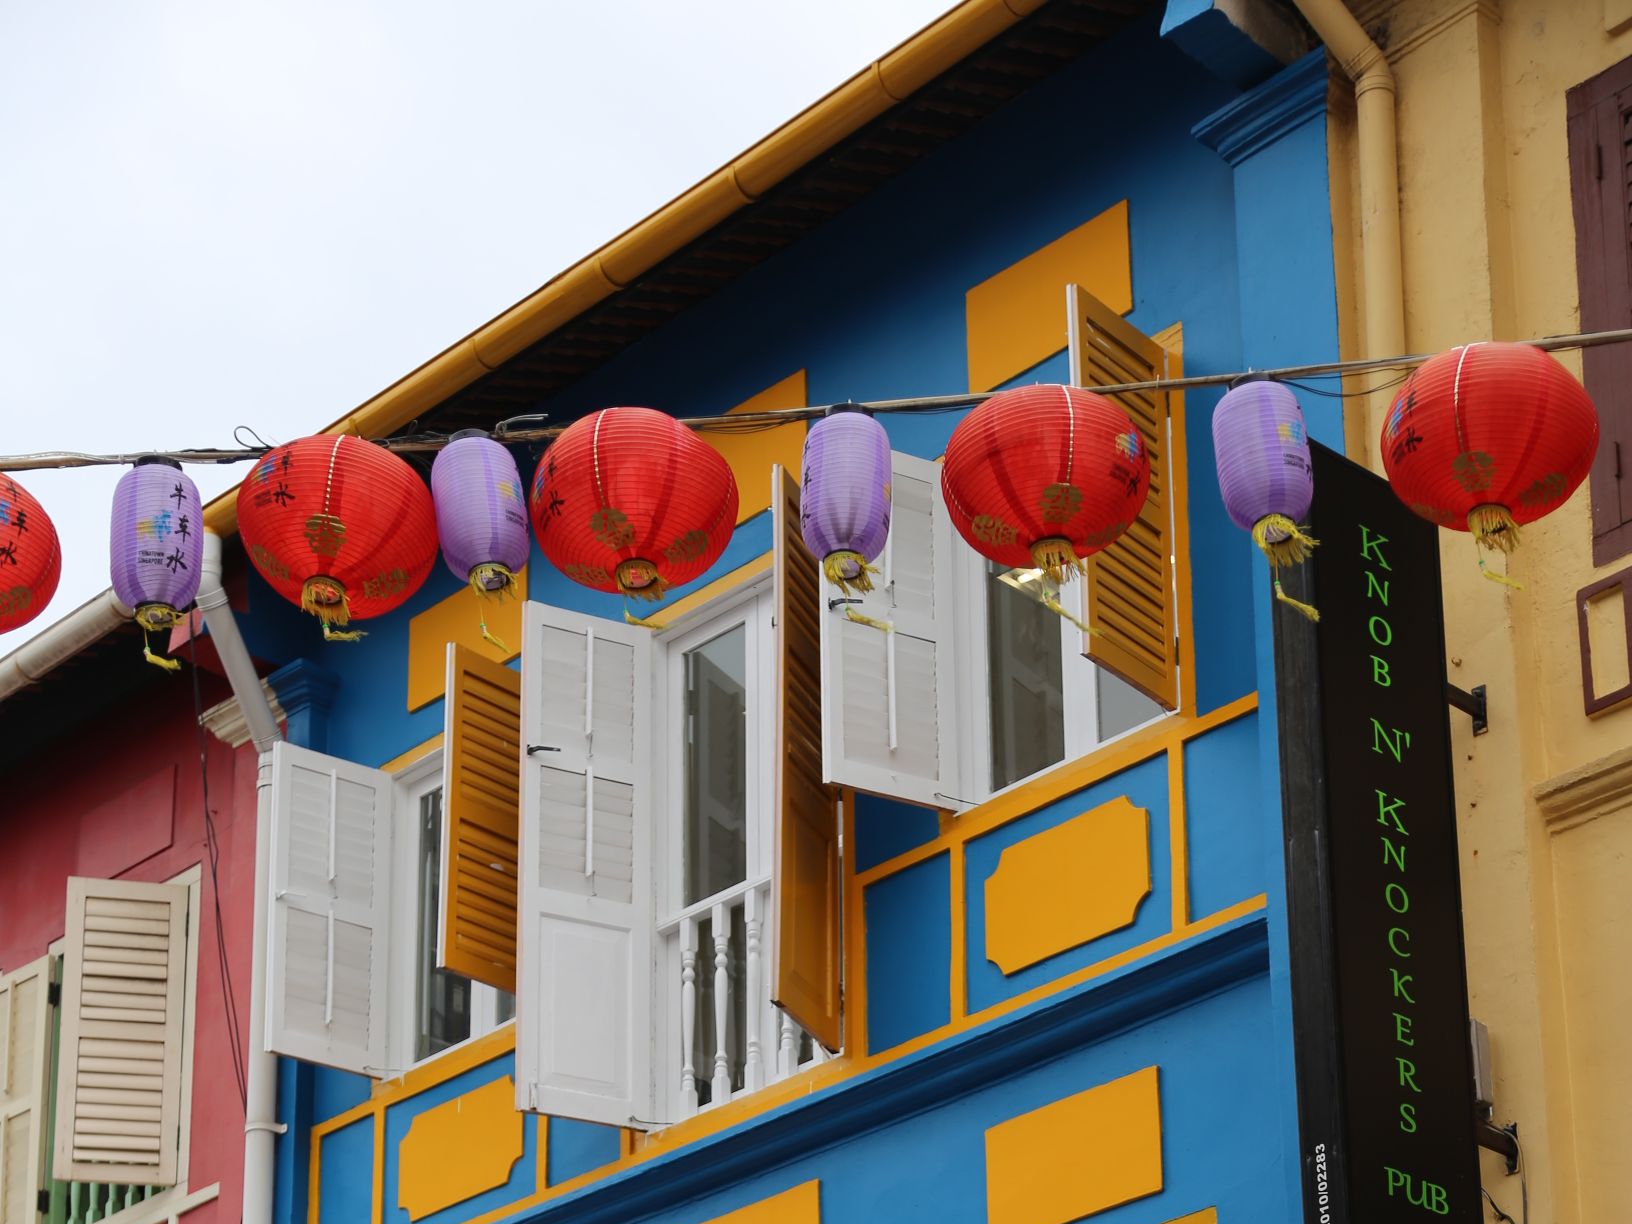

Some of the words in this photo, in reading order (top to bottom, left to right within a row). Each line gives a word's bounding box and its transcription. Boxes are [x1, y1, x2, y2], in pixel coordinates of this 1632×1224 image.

[1358, 524, 1393, 688] KNOB
[1374, 790, 1423, 1134] KNOCKERS
[1383, 1165, 1450, 1216] PUB
